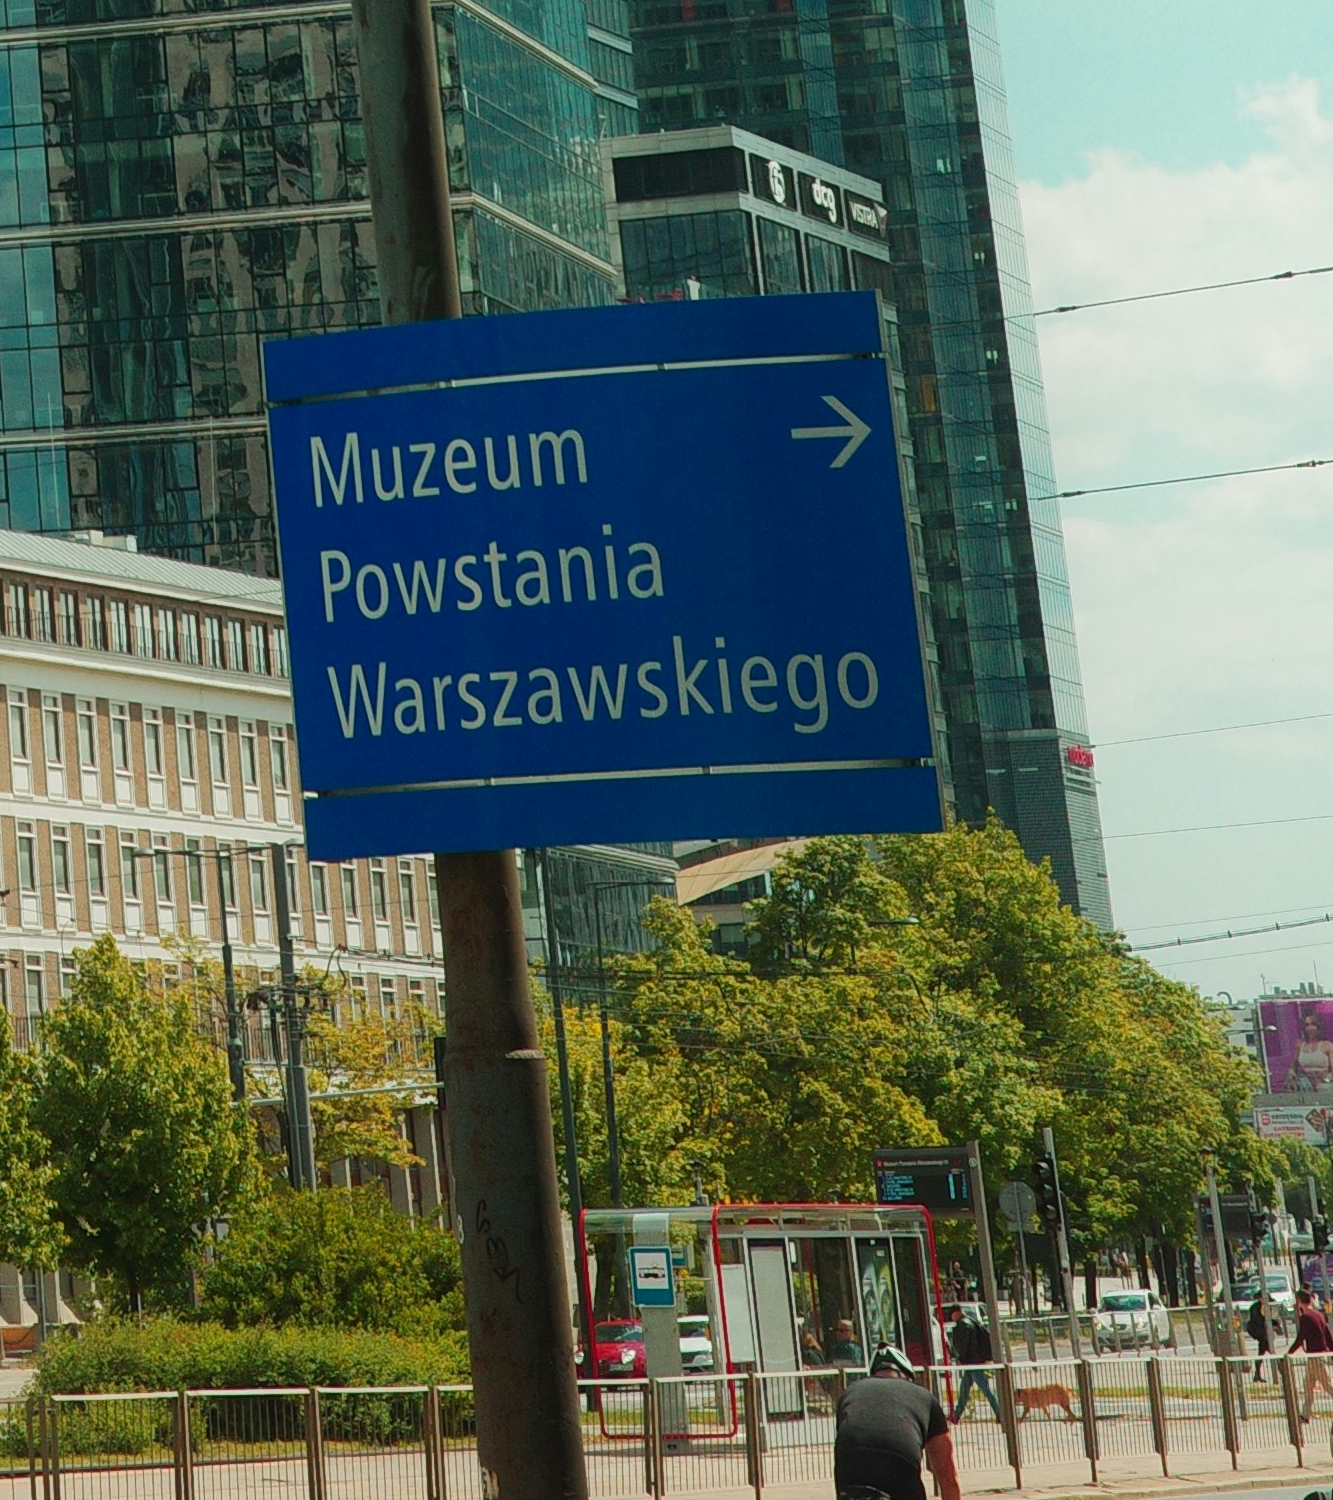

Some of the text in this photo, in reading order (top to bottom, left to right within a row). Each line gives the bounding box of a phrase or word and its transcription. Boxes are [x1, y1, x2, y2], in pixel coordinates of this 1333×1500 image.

[309, 426, 589, 508] Muzeum
[319, 523, 665, 623] Powstania
[326, 635, 880, 740] Warszawskiego
